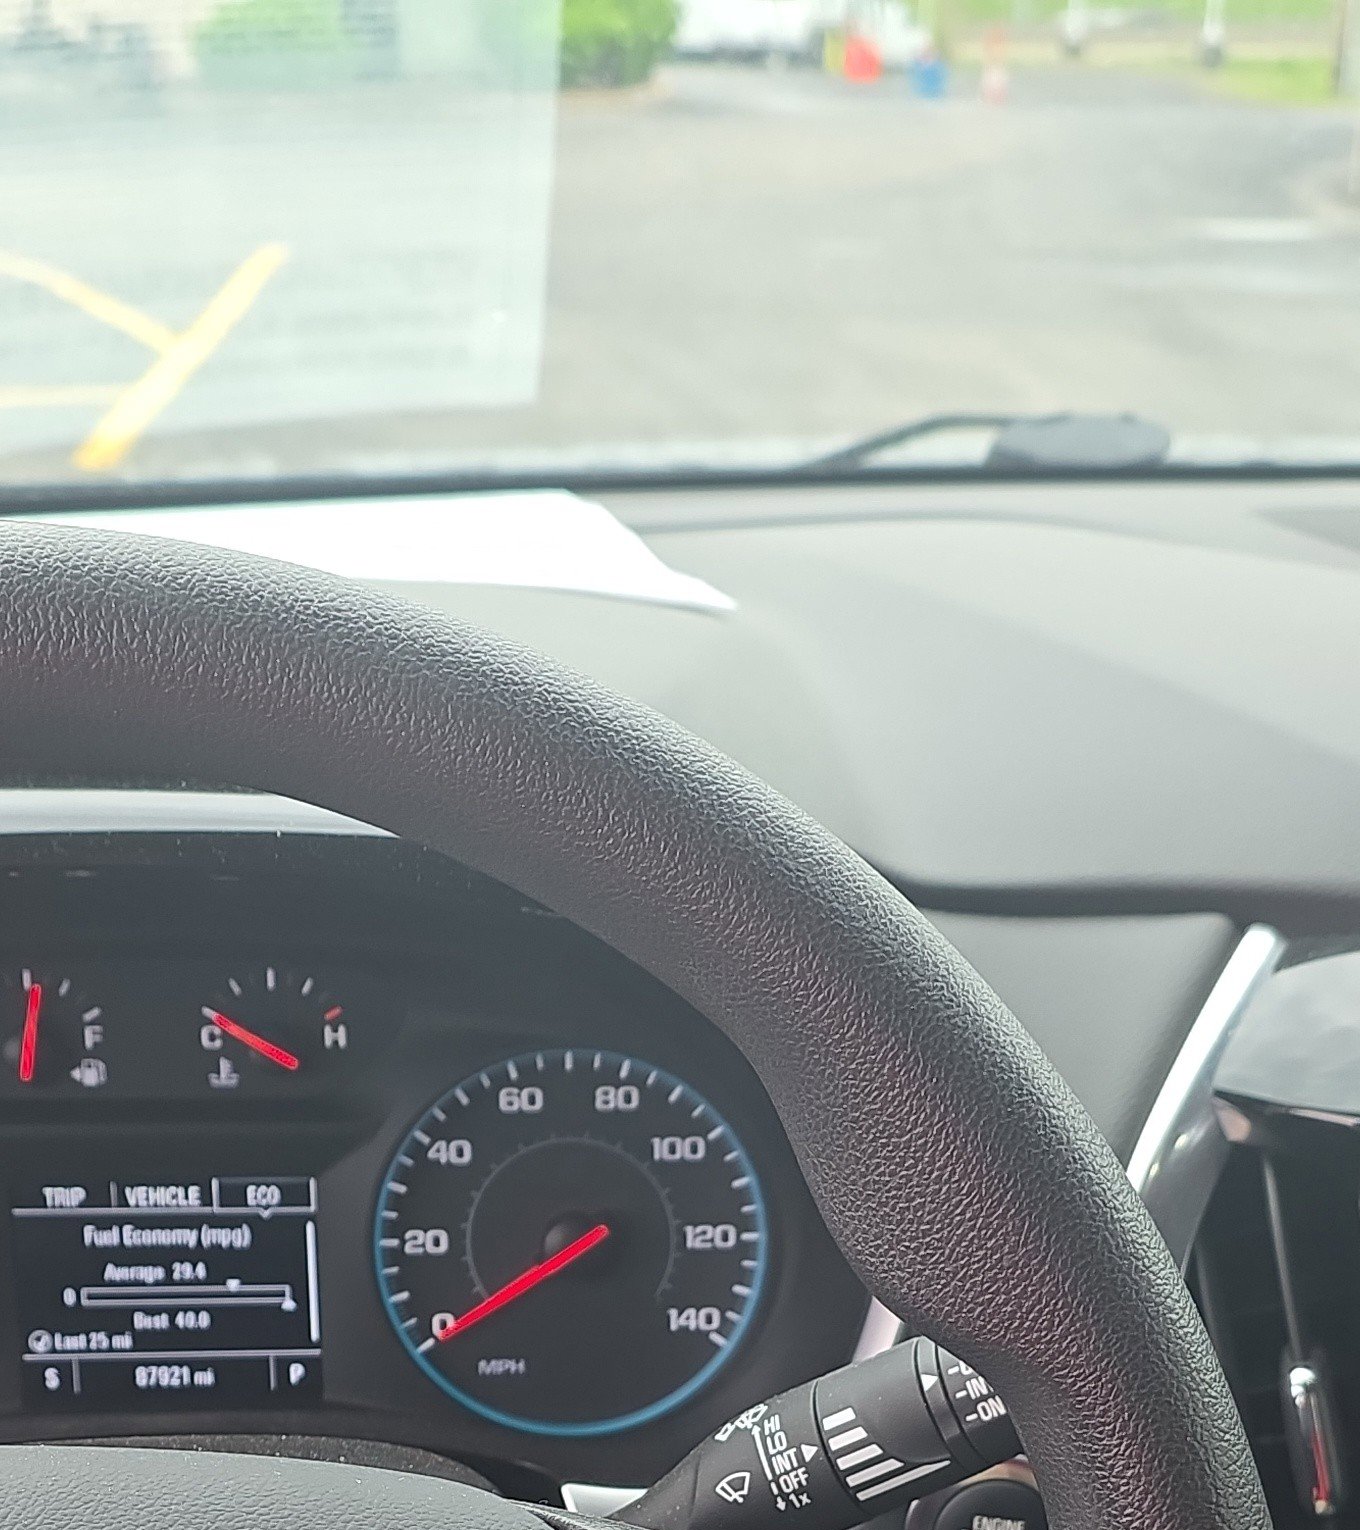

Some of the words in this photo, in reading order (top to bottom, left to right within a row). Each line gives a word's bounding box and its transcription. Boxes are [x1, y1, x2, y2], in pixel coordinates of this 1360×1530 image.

[83, 1025, 104, 1050] F
[200, 1025, 223, 1050] C
[324, 1024, 348, 1049] H
[498, 1086, 544, 1114] 60
[594, 1085, 639, 1113] 80
[426, 1138, 473, 1166] 40
[650, 1136, 707, 1162] 100
[42, 1186, 87, 1208] TRIP
[124, 1185, 202, 1207] VEHICLE
[246, 1184, 282, 1206] ECO
[83, 1224, 120, 1247] Fuel
[121, 1224, 198, 1248] Economy
[200, 1223, 252, 1250] (mpg)
[403, 1229, 450, 1255] 20
[683, 1224, 738, 1250] 120
[103, 1262, 166, 1284] Average
[432, 1312, 456, 1339] 0
[667, 1307, 721, 1332] 140
[193, 1367, 216, 1387] mi
[478, 1358, 526, 1376] MPH
[966, 1376, 994, 1400] IN
[764, 1414, 781, 1436] HI
[766, 1431, 788, 1455] LO
[771, 1447, 799, 1475] INT
[779, 1467, 809, 1493] OFF
